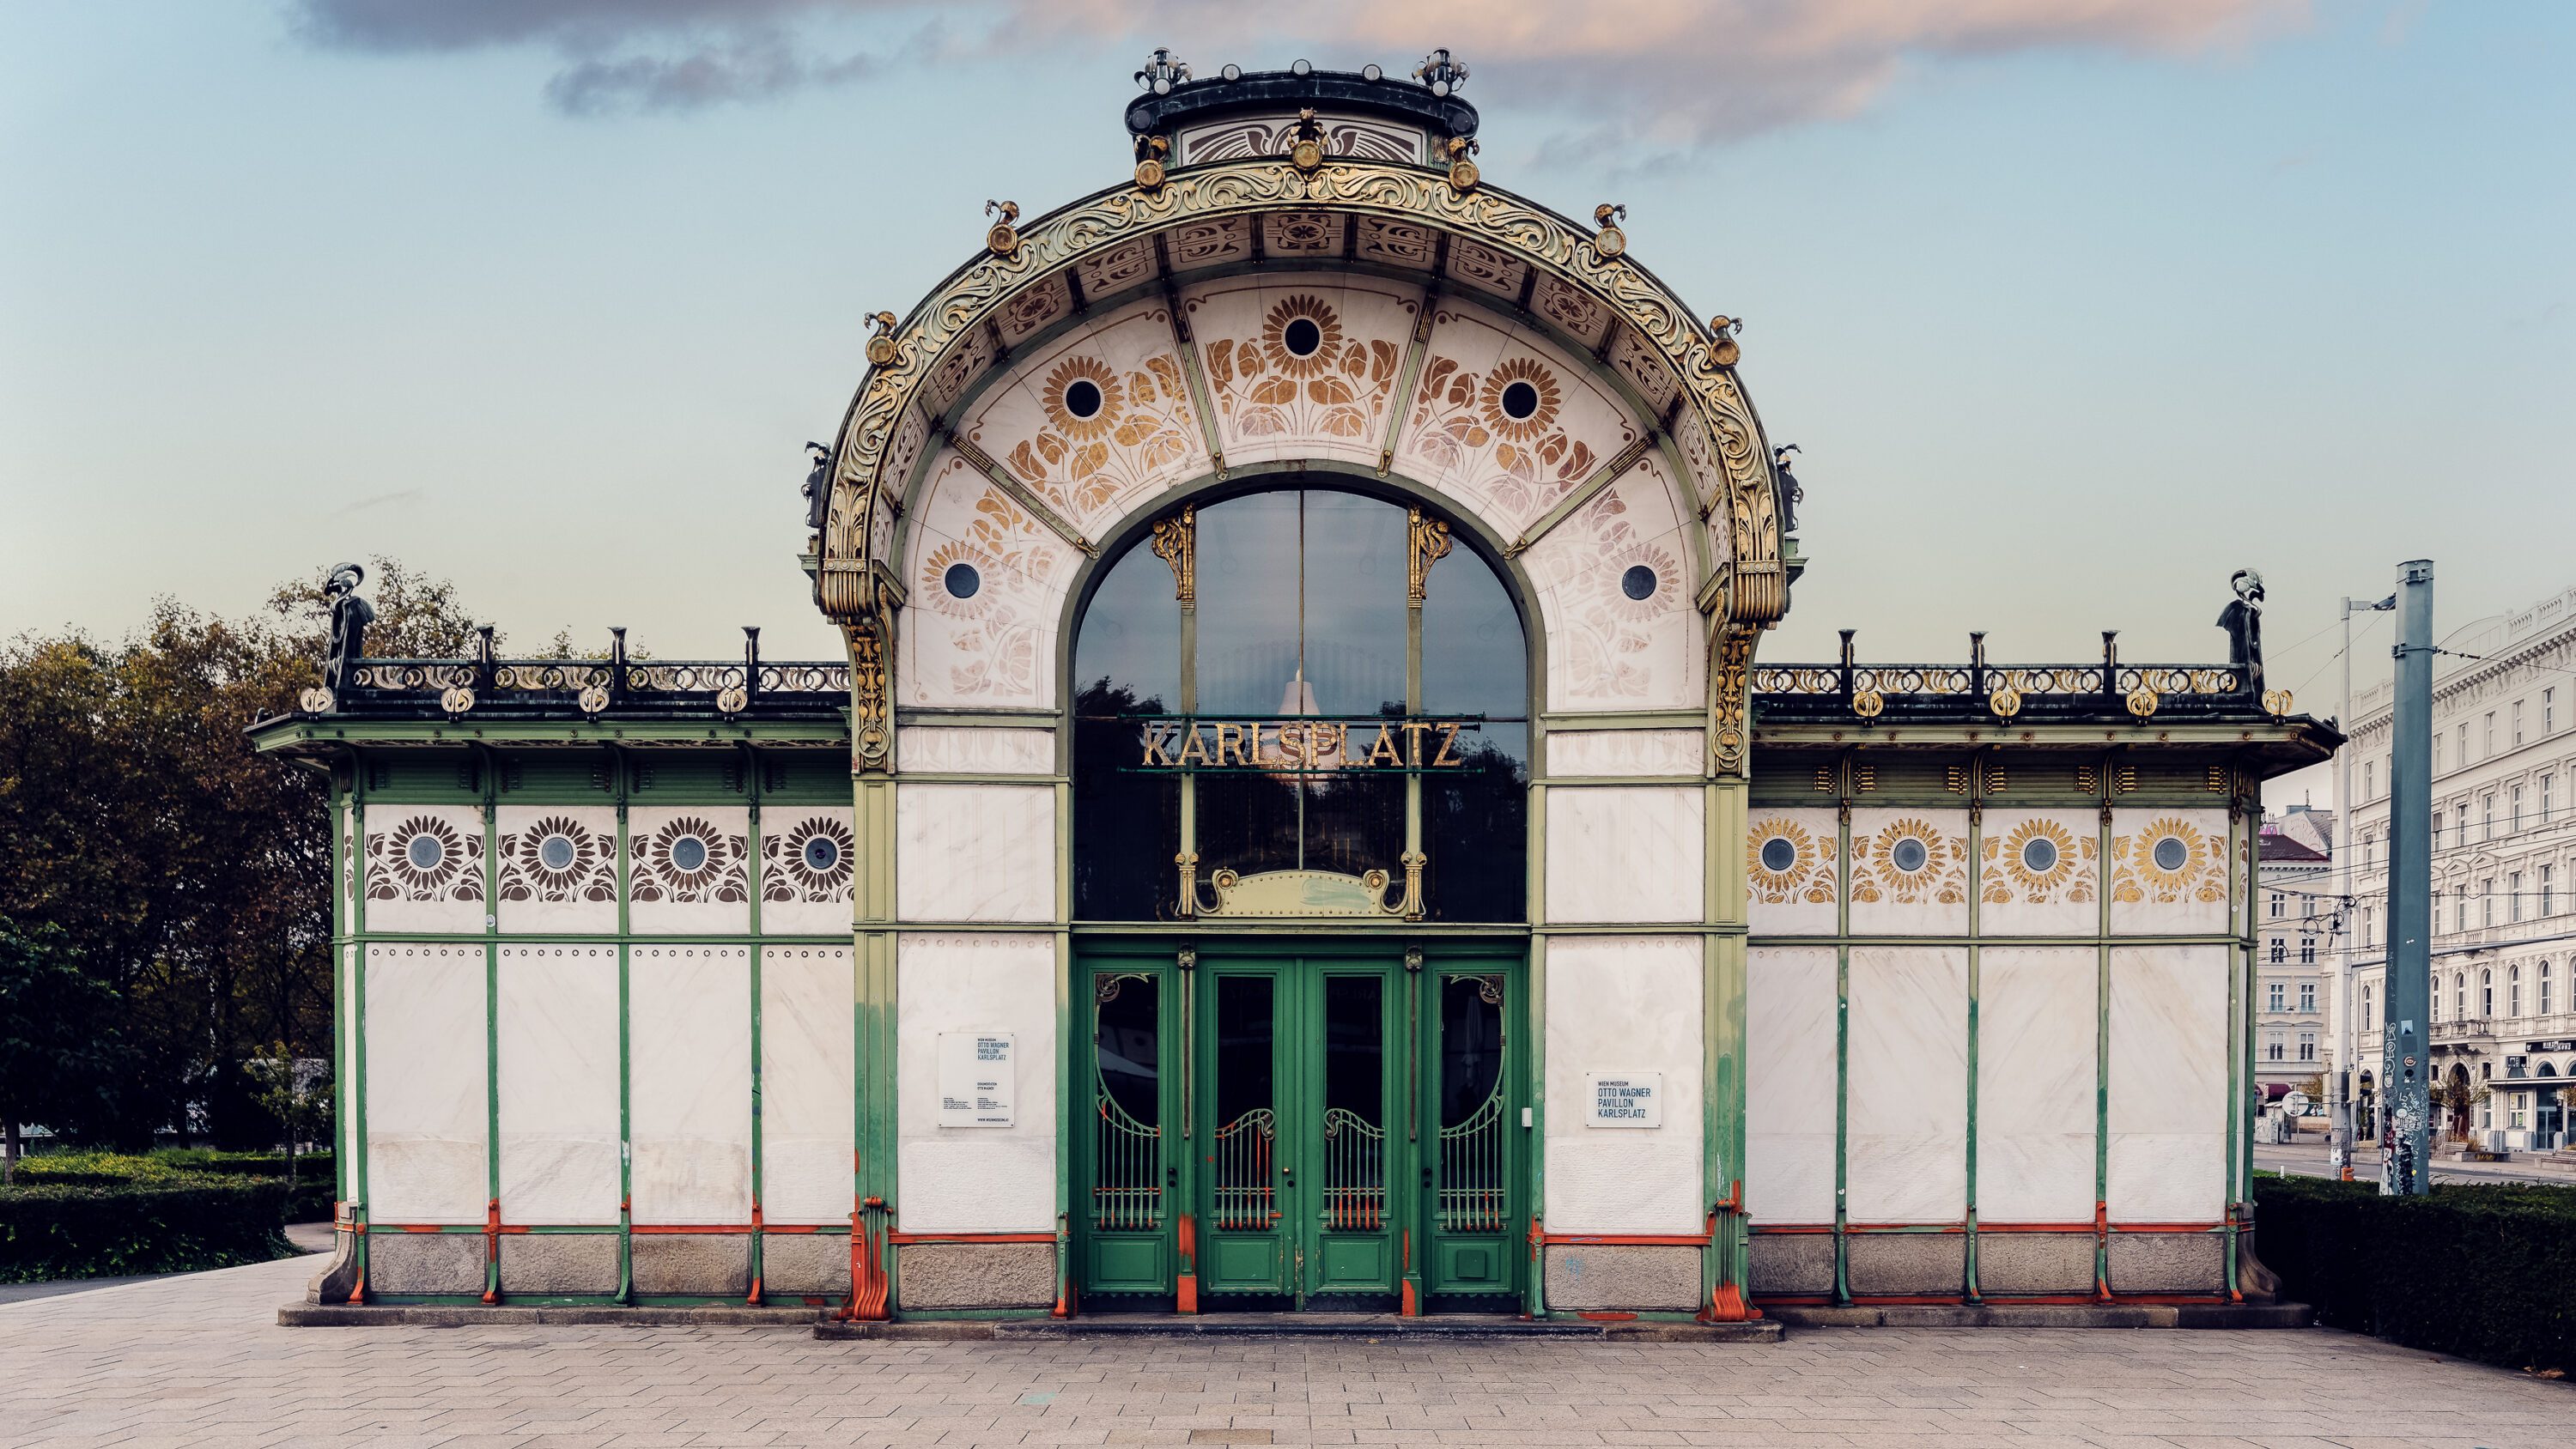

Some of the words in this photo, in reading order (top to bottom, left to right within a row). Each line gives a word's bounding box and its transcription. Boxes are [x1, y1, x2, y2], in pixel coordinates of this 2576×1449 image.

[1141, 722, 1461, 767] KARLSPLATZ
[1598, 1088, 1617, 1097] OTTO
[1619, 1088, 1651, 1097] WAGNER
[1598, 1098, 1633, 1107] PAVILLON
[1598, 1108, 1646, 1118] KARLSPLATZ
